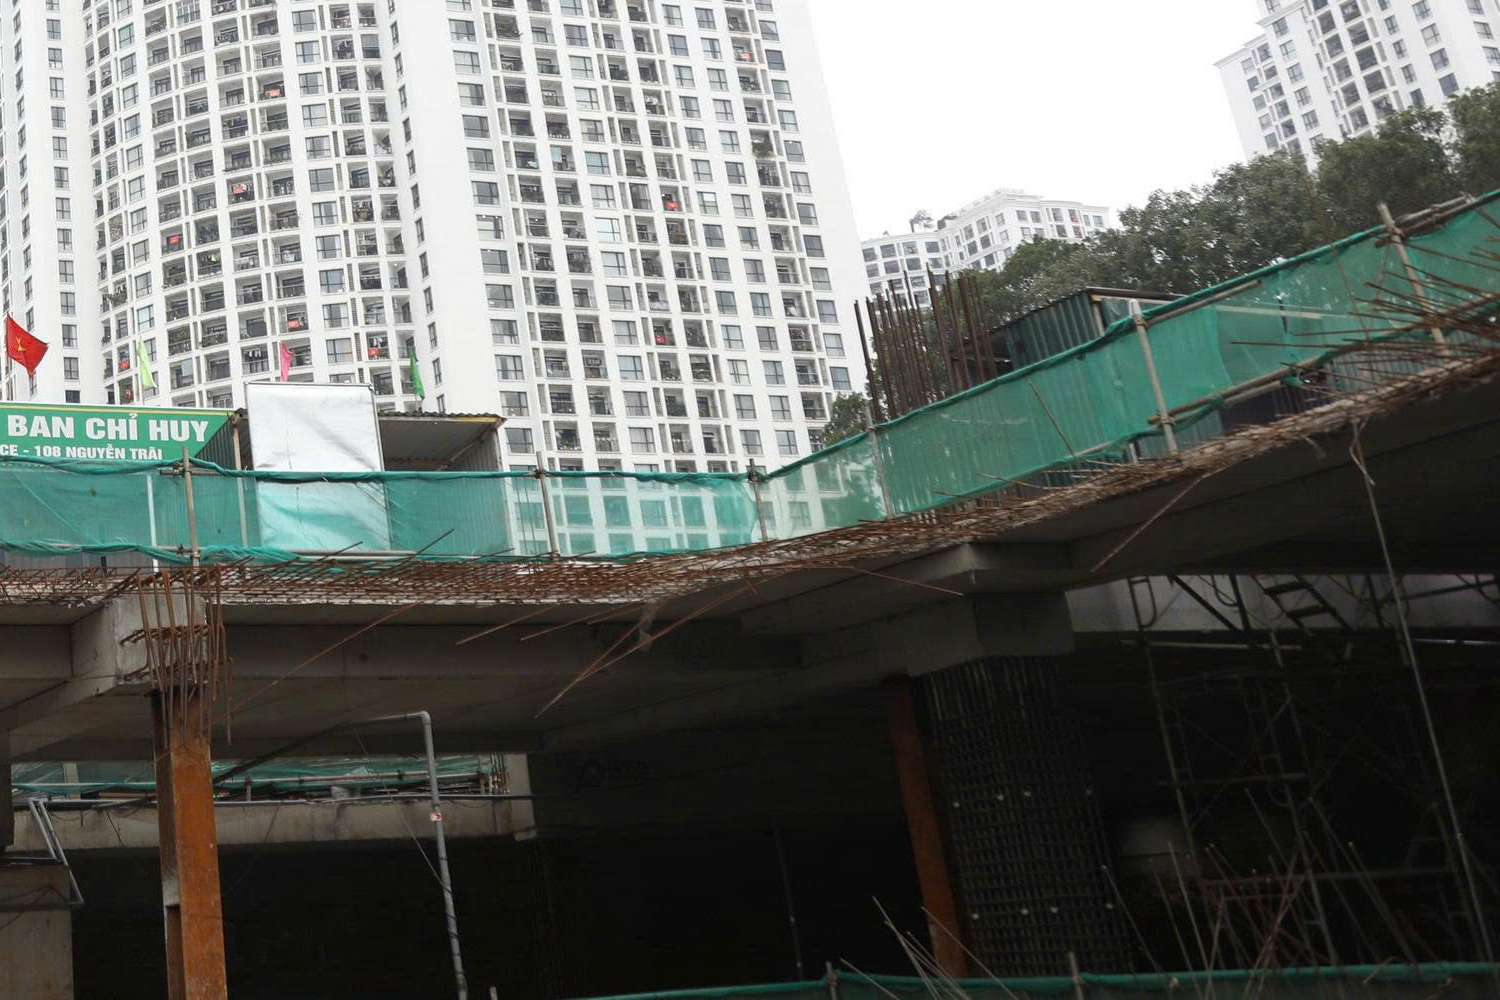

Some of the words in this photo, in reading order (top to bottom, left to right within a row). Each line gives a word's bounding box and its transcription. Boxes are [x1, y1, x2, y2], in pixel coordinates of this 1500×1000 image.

[7, 415, 75, 438] BAN
[85, 412, 138, 440] CHỈ
[148, 419, 209, 442] HUY
[34, 445, 61, 457] 108
